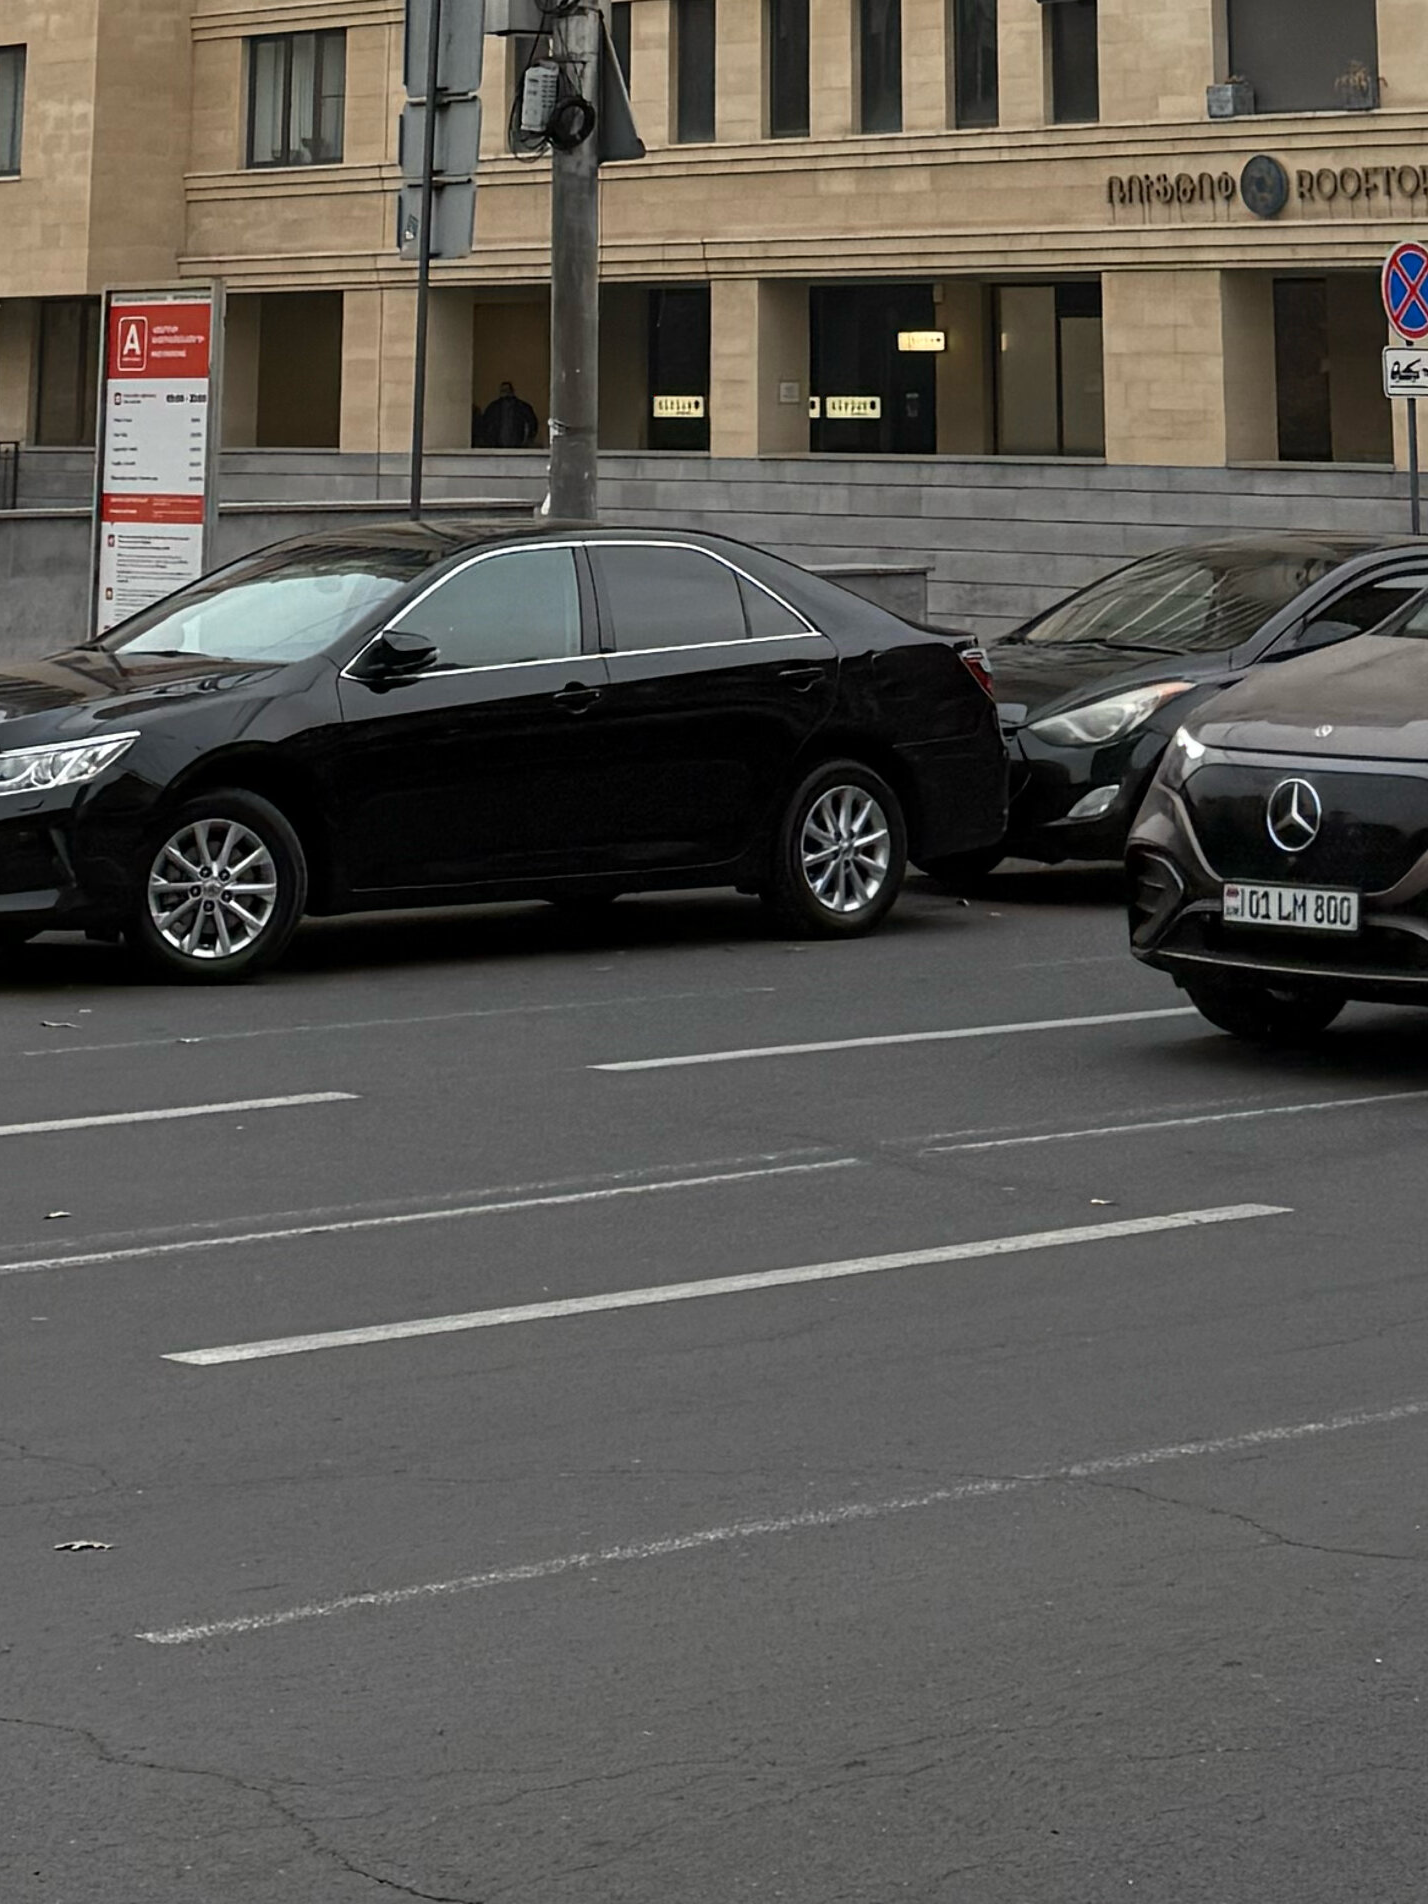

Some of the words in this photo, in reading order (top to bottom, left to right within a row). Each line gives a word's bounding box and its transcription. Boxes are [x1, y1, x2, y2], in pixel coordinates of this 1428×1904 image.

[123, 323, 142, 356] A
[1248, 889, 1272, 920] 01
[1278, 892, 1307, 923] LM
[1313, 894, 1352, 926] 800
